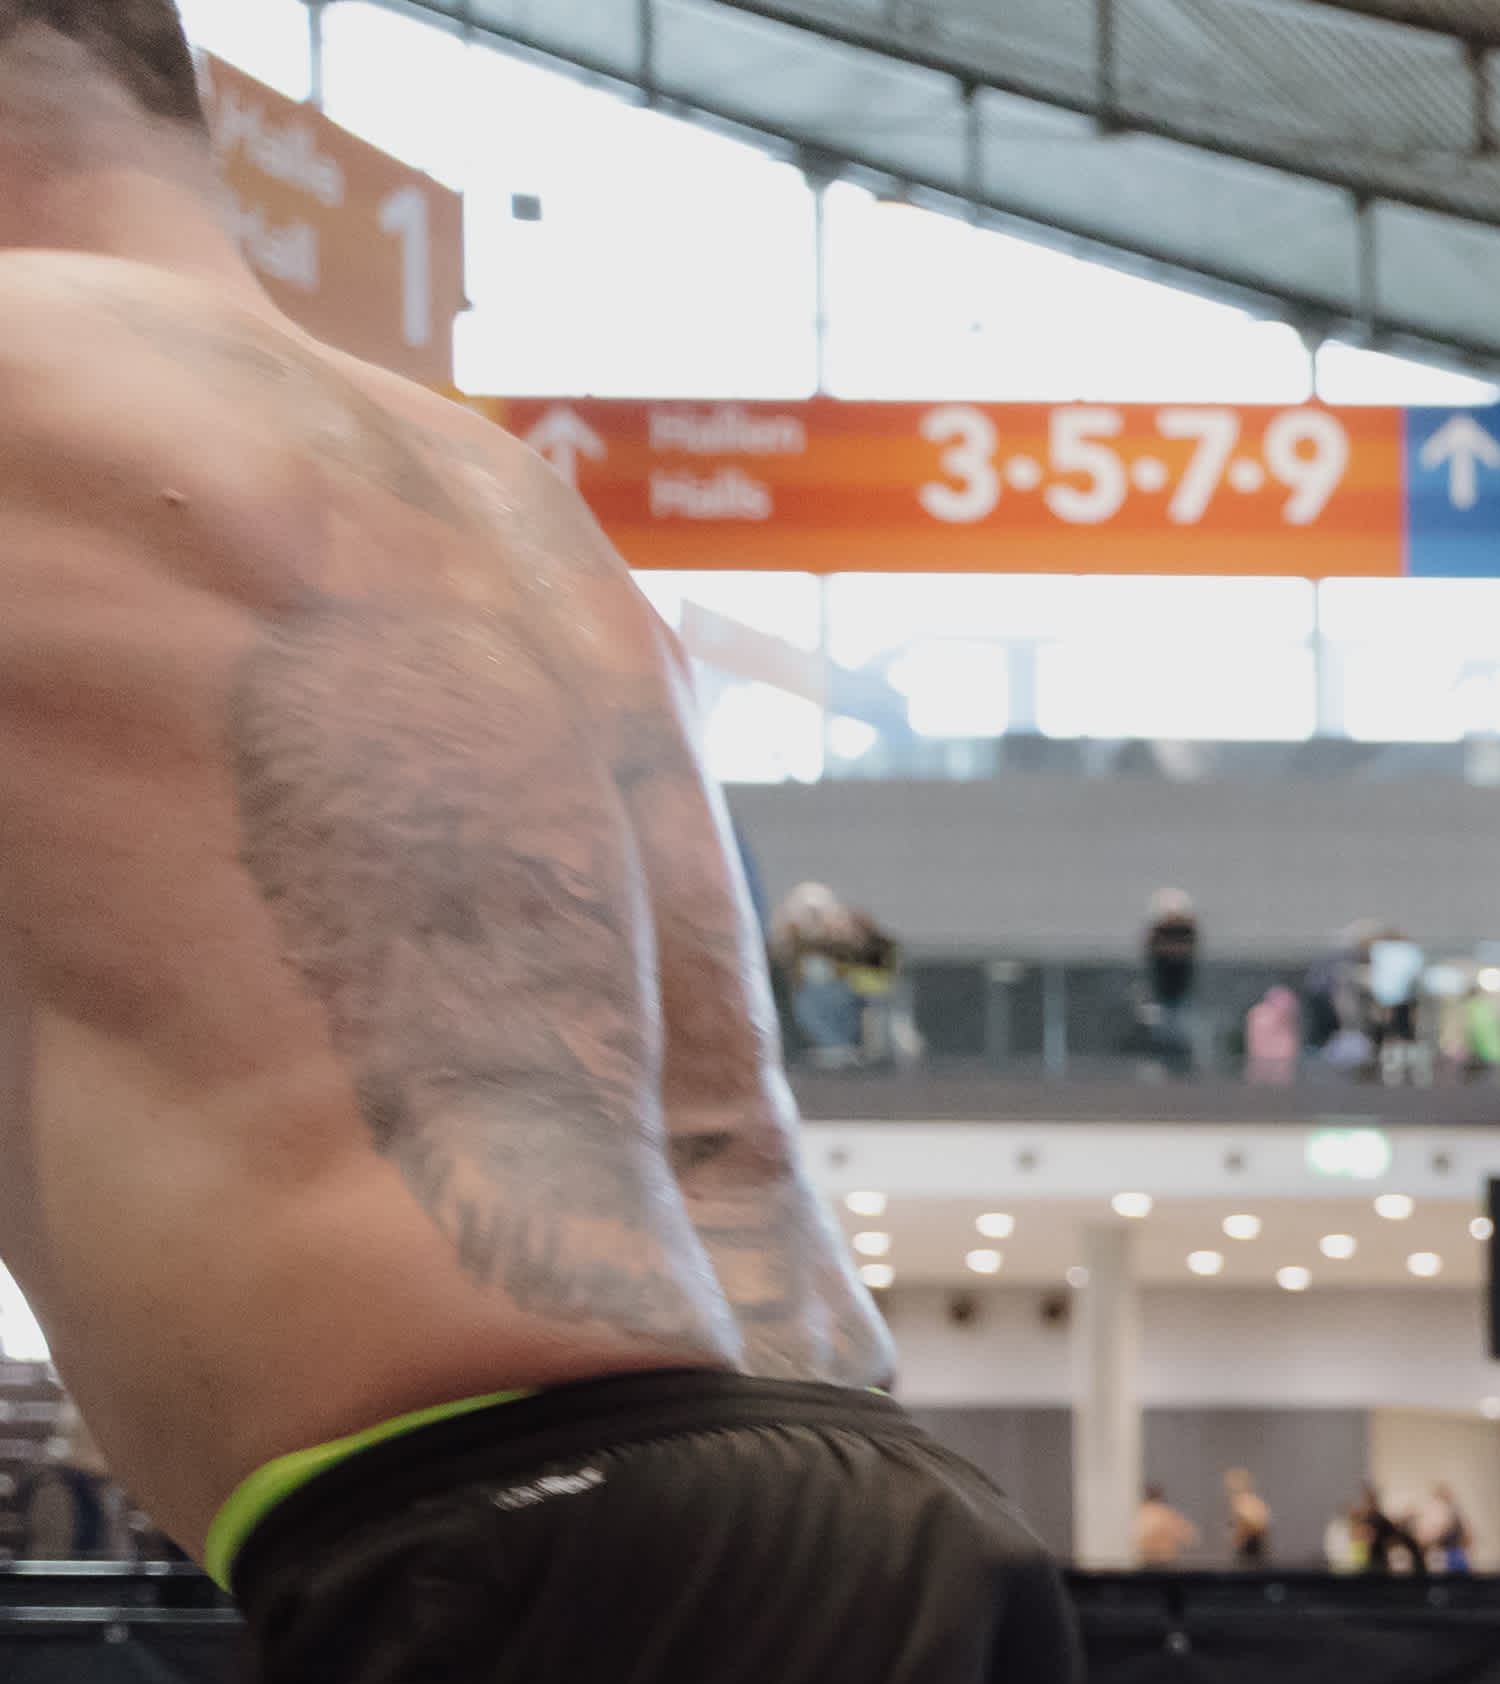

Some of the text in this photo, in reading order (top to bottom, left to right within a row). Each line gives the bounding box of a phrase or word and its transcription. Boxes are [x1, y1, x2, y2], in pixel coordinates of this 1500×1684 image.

[379, 186, 429, 346] 1
[650, 402, 806, 454] Hallen
[650, 468, 772, 520] Halls
